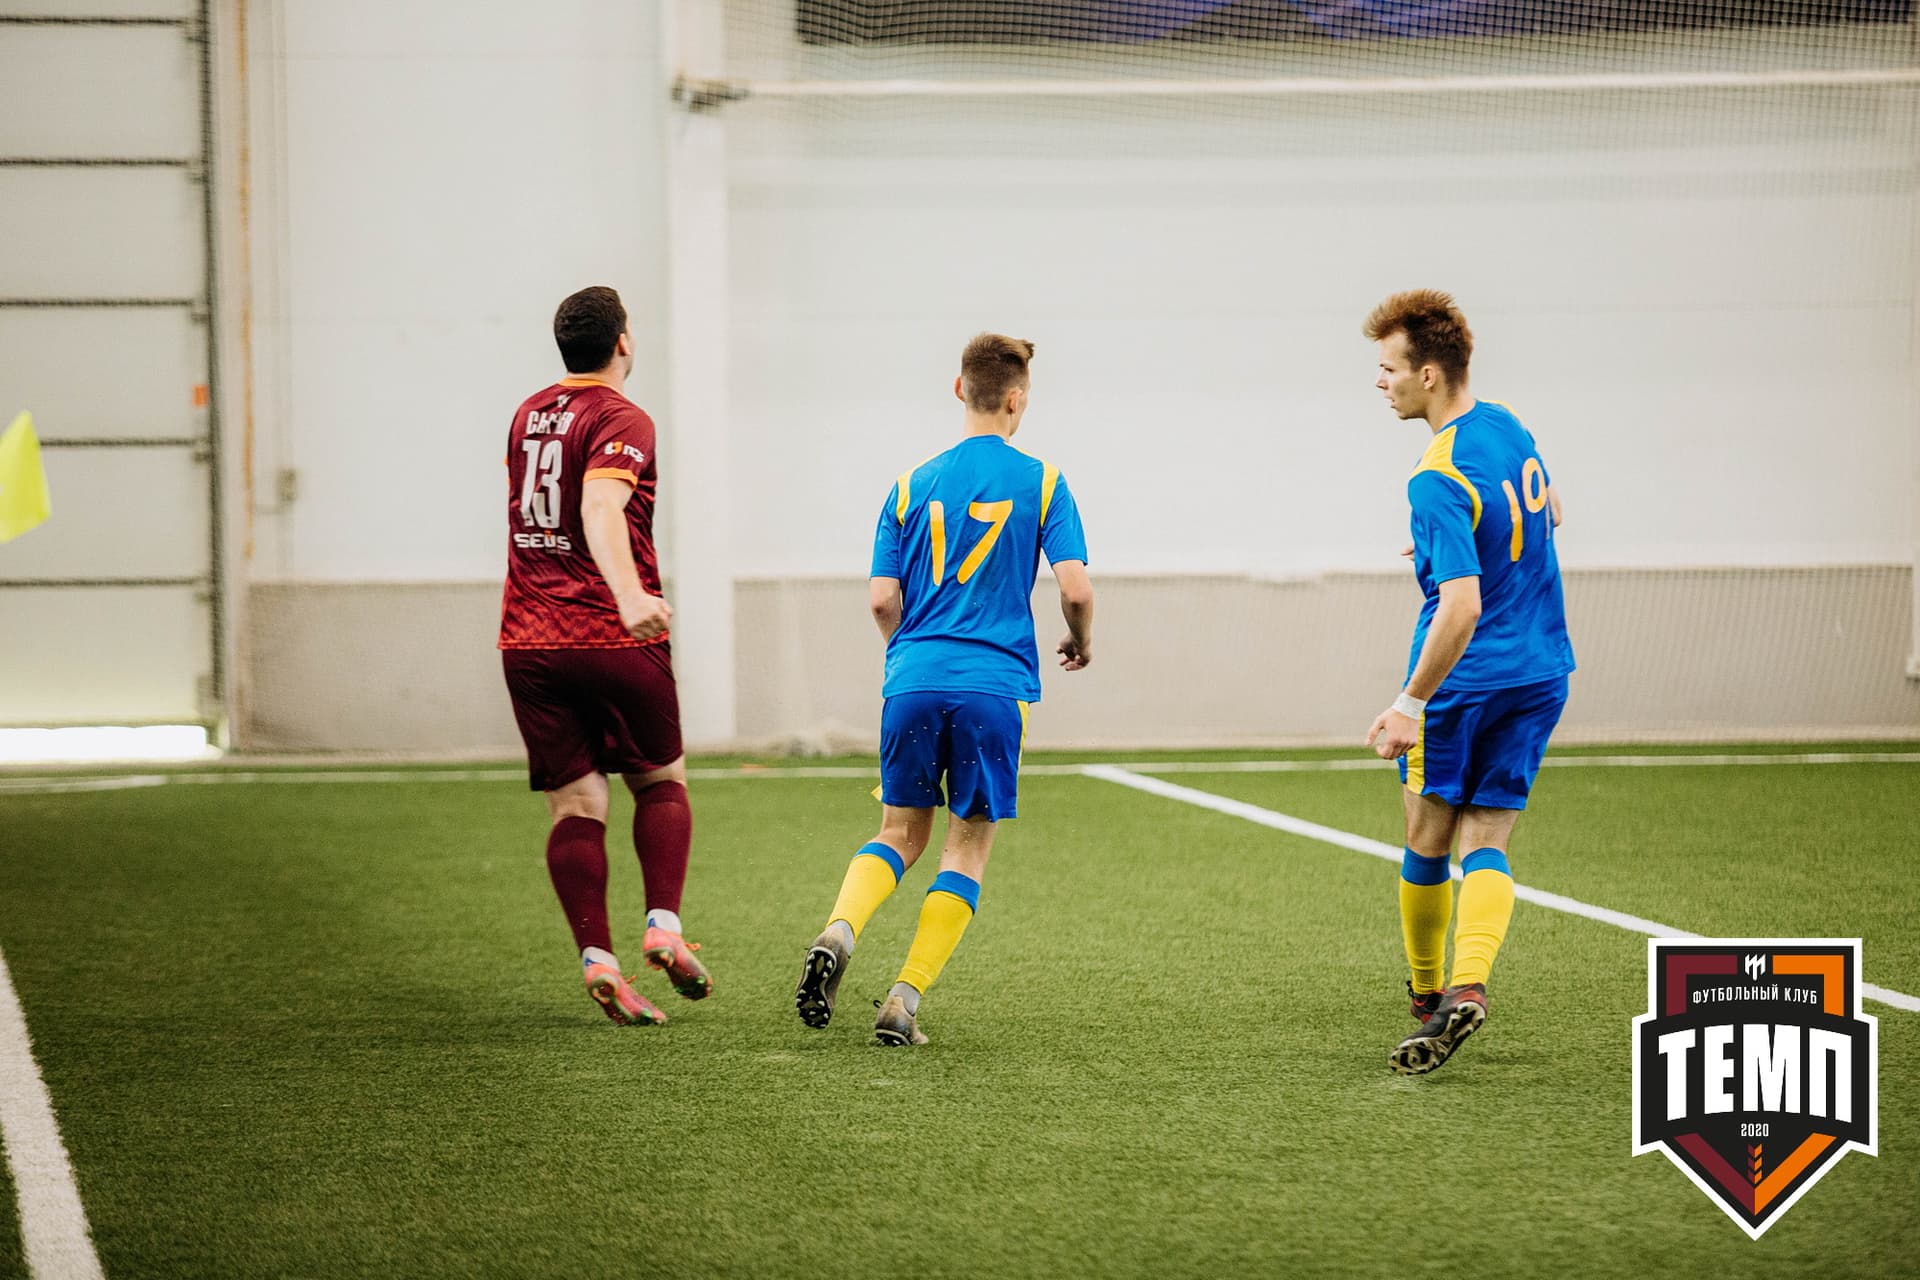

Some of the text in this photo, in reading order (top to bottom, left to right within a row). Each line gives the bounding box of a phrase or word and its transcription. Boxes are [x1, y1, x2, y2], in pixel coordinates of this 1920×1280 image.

[520, 439, 563, 529] 13
[1501, 457, 1551, 562] 19
[929, 499, 1013, 586] 17
